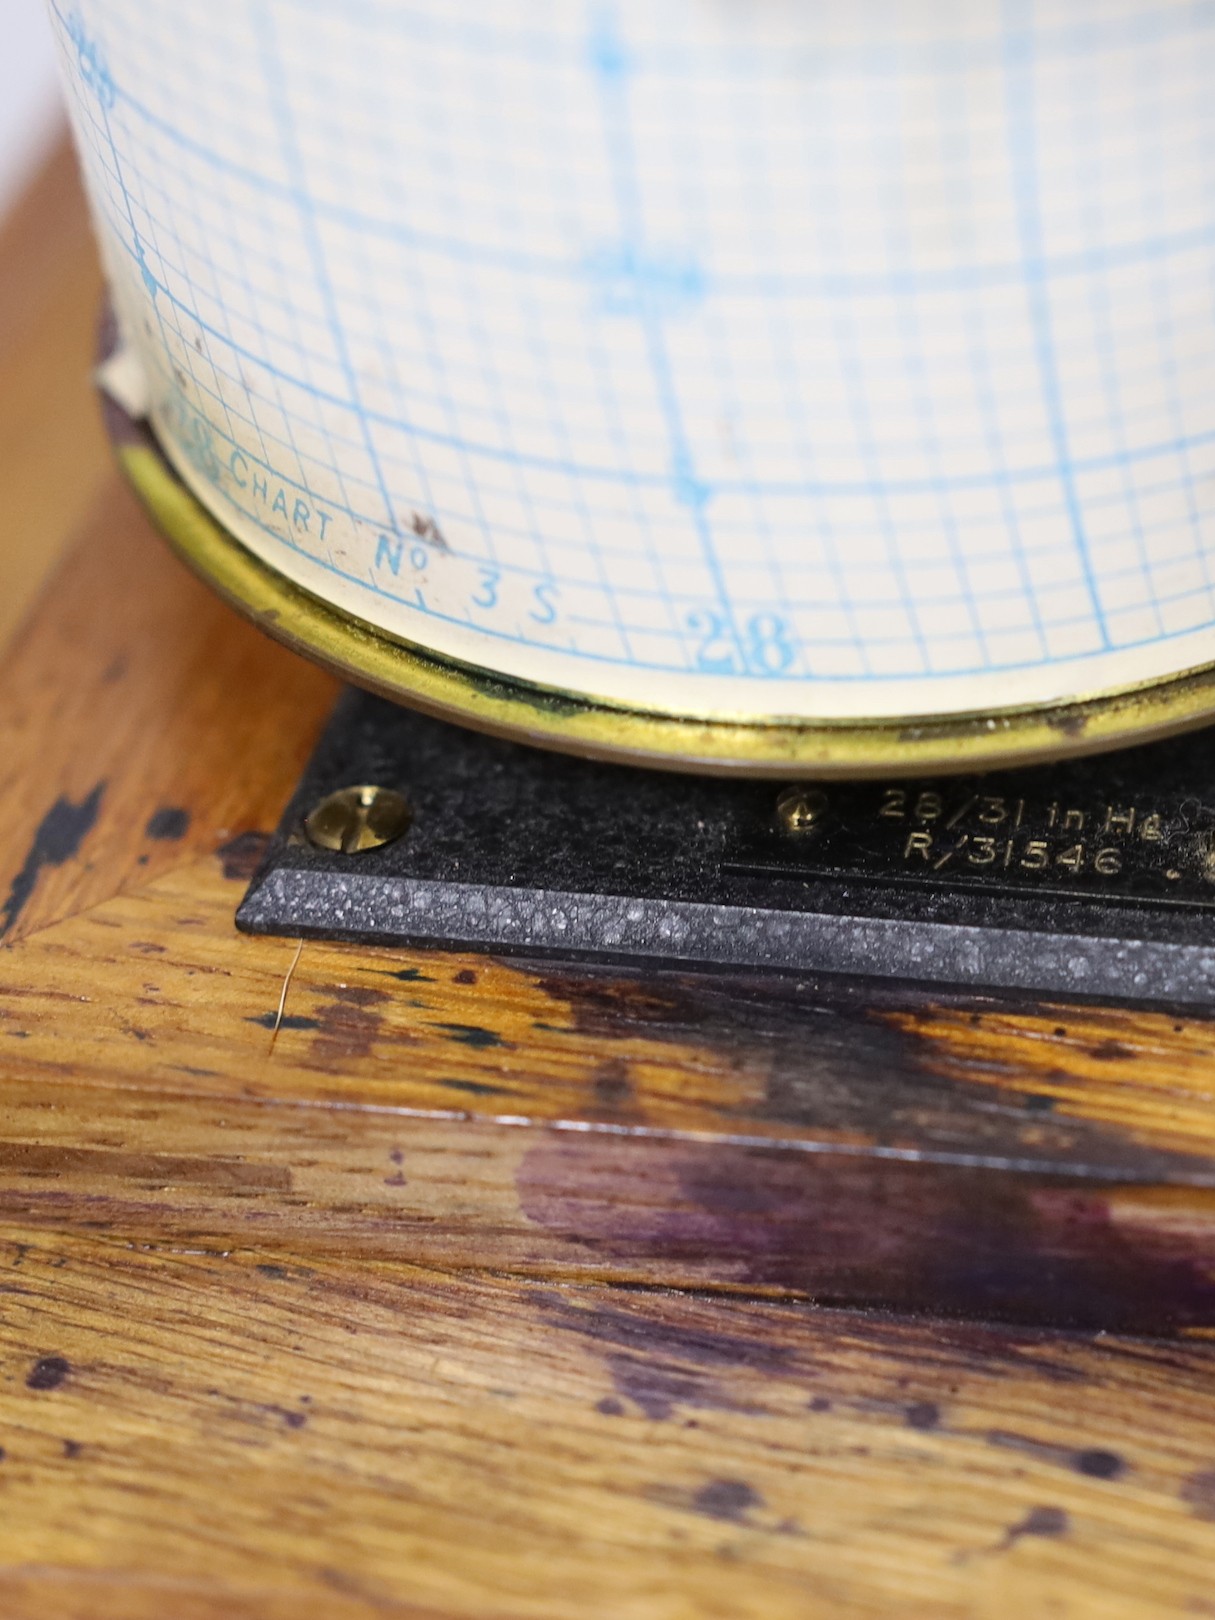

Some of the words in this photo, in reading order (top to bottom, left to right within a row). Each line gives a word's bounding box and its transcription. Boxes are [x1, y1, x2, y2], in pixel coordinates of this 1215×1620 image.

[230, 450, 333, 541] CHART
[472, 565, 503, 608] 3
[685, 608, 796, 676] 28
[903, 830, 1123, 875] R/31546
